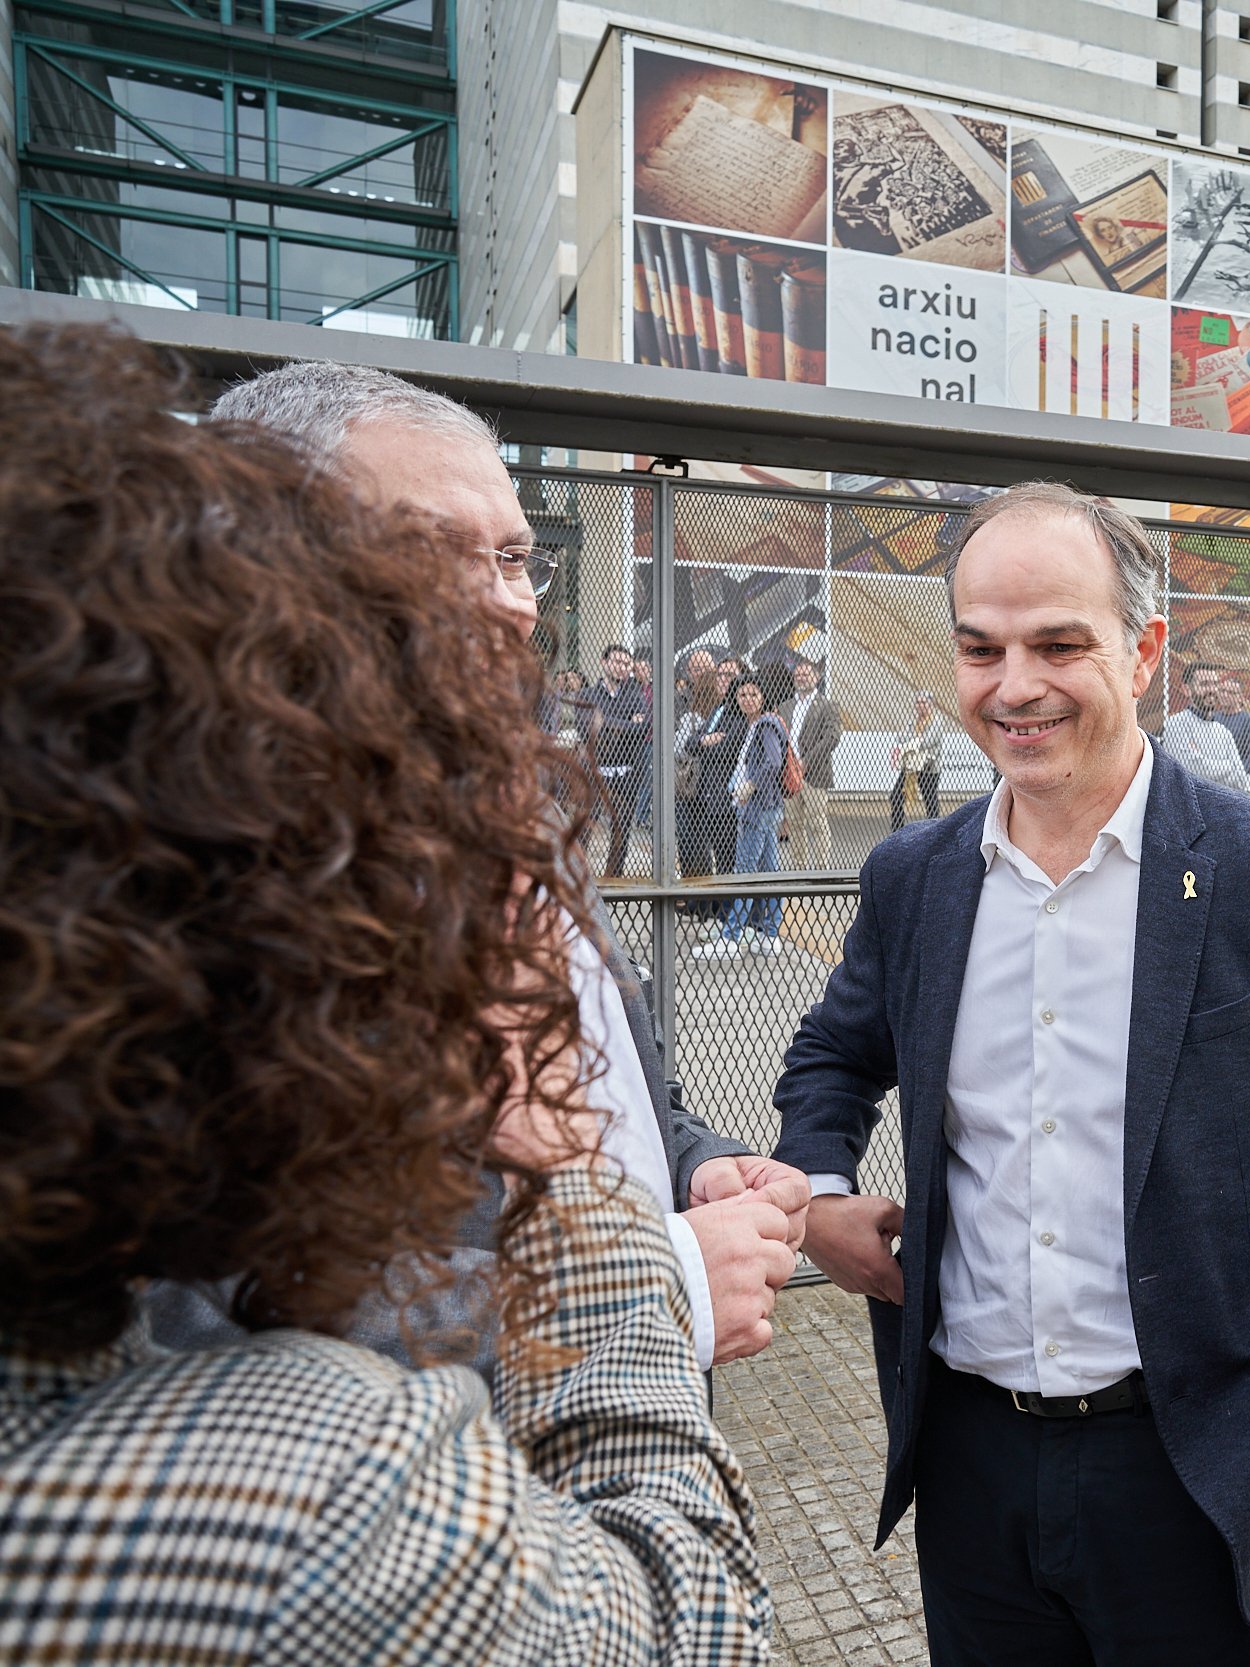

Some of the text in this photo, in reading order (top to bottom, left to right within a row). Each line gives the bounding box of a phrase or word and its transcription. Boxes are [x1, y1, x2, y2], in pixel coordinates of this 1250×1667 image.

[878, 283, 976, 320] arxiu
[871, 327, 977, 363] nacio
[921, 374, 976, 403] nal
